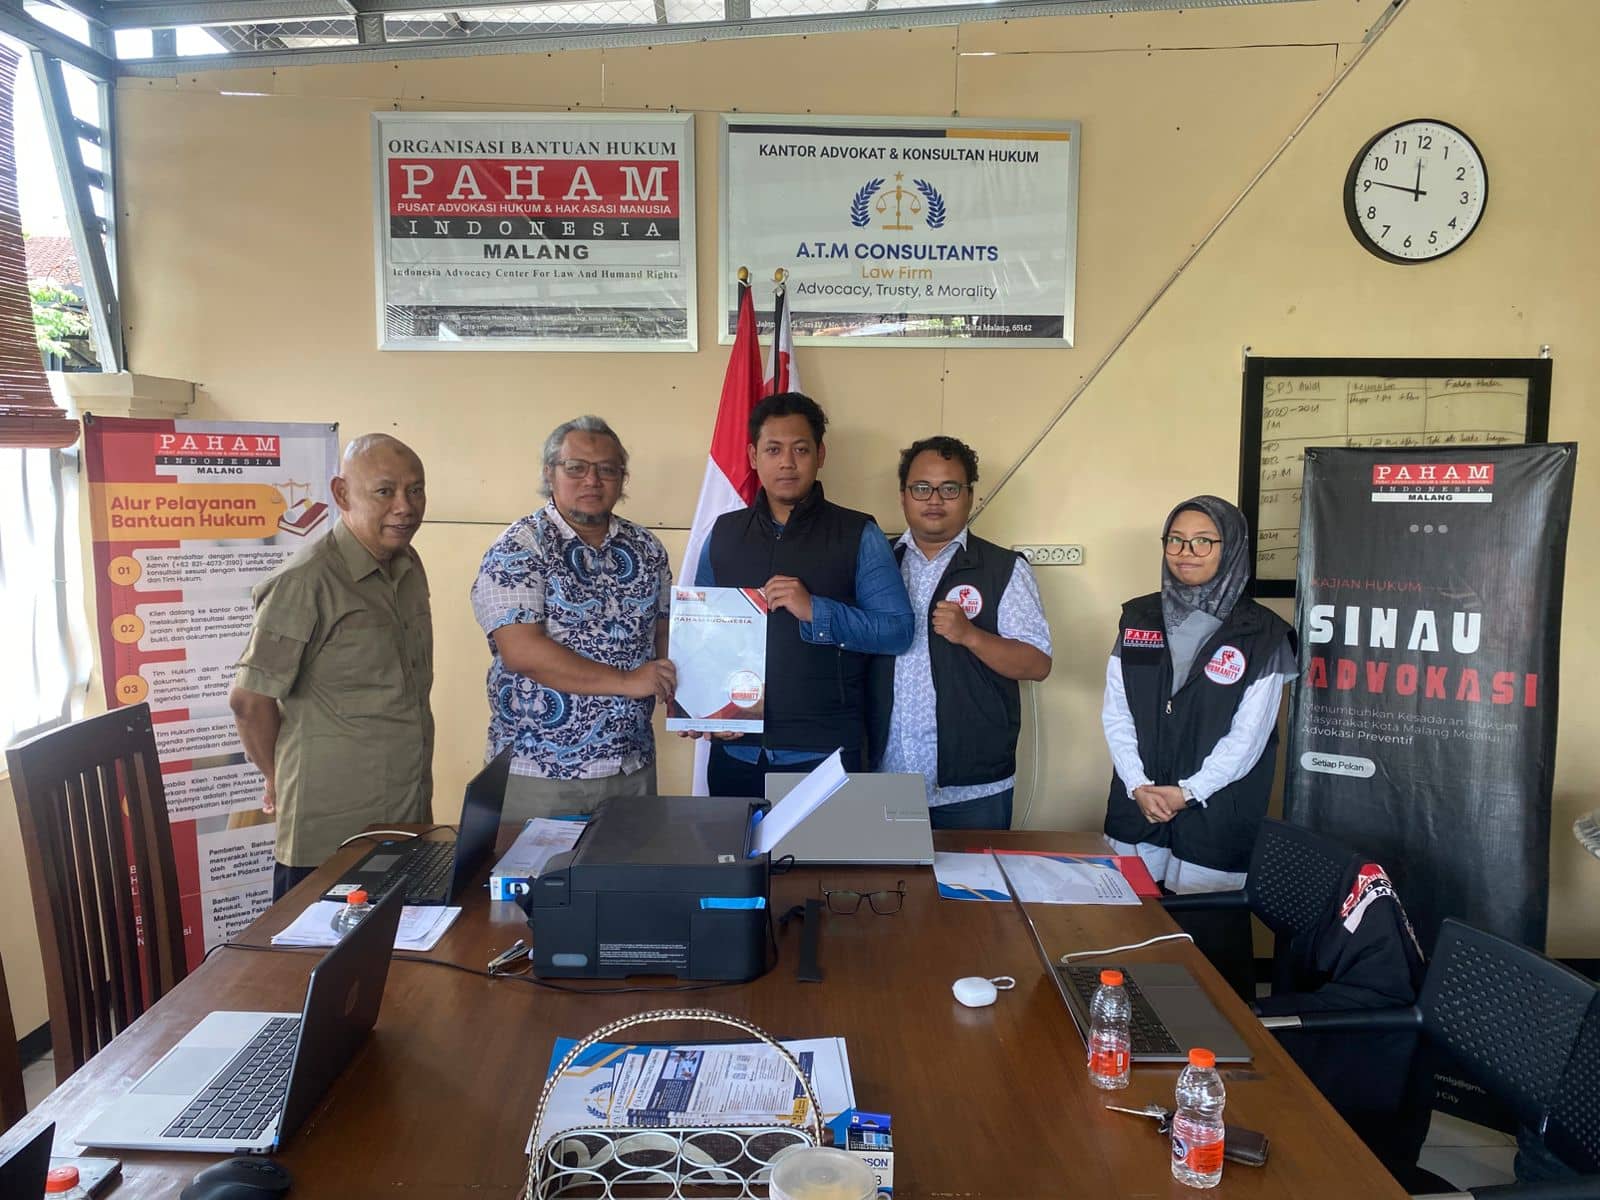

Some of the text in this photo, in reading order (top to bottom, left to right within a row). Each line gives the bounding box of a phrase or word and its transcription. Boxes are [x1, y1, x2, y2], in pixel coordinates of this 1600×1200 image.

[388, 139, 677, 156] ORGANISASI BANTUAN HUKUM
[1395, 140, 1407, 155] 11
[1418, 136, 1432, 150] 12
[759, 144, 1039, 163] KANTOR ADVOKAT & KONSULTAN HUKUM
[1443, 146, 1449, 160] 1
[1374, 157, 1388, 171] 10
[1455, 167, 1466, 181] 2
[400, 164, 669, 202] PAHAM
[1363, 179, 1372, 192] 9
[1459, 191, 1469, 205] 3
[397, 203, 672, 215] PUSAT ADVOKASI HUKUM & HAK ASASI MANUSIA
[1367, 206, 1376, 219] 8
[409, 220, 661, 237] INDONESIA
[1448, 216, 1457, 229] 4
[1381, 225, 1391, 238] 7
[1428, 231, 1438, 244] 5
[1403, 235, 1412, 248] 6
[483, 244, 590, 261] MALANG
[796, 242, 998, 262] A.T.M CONSULTANTS
[393, 268, 678, 280] Indonesia Advocacy Center For Law And Humand Rights
[862, 266, 933, 280] Law Firm
[797, 282, 997, 300] Advocacy, Trusty, & Morality
[160, 434, 275, 452] PAHAM
[164, 457, 272, 465] INDONESIA
[197, 467, 243, 475] MALANG
[1378, 465, 1490, 480] PAHAM
[111, 496, 256, 513] Alur Pelayanan
[111, 513, 266, 529] Bantuan Hukum
[118, 566, 131, 576] 01
[1365, 580, 1422, 592] HUKUM
[120, 624, 135, 633] 02
[1127, 630, 1159, 639] PAHA
[1309, 604, 1482, 654] SINAU
[1307, 657, 1538, 707] ADVOKASI
[123, 684, 138, 695] 03
[1303, 703, 1394, 720] Menumbuhkan
[1398, 711, 1464, 726] Kesadaran
[1302, 726, 1415, 745] Advokasi Preventif
[1372, 720, 1399, 733] Kota
[1403, 723, 1449, 740] Malang
[1312, 758, 1364, 772] Setiap Pekan
[864, 1159, 888, 1167] SON
